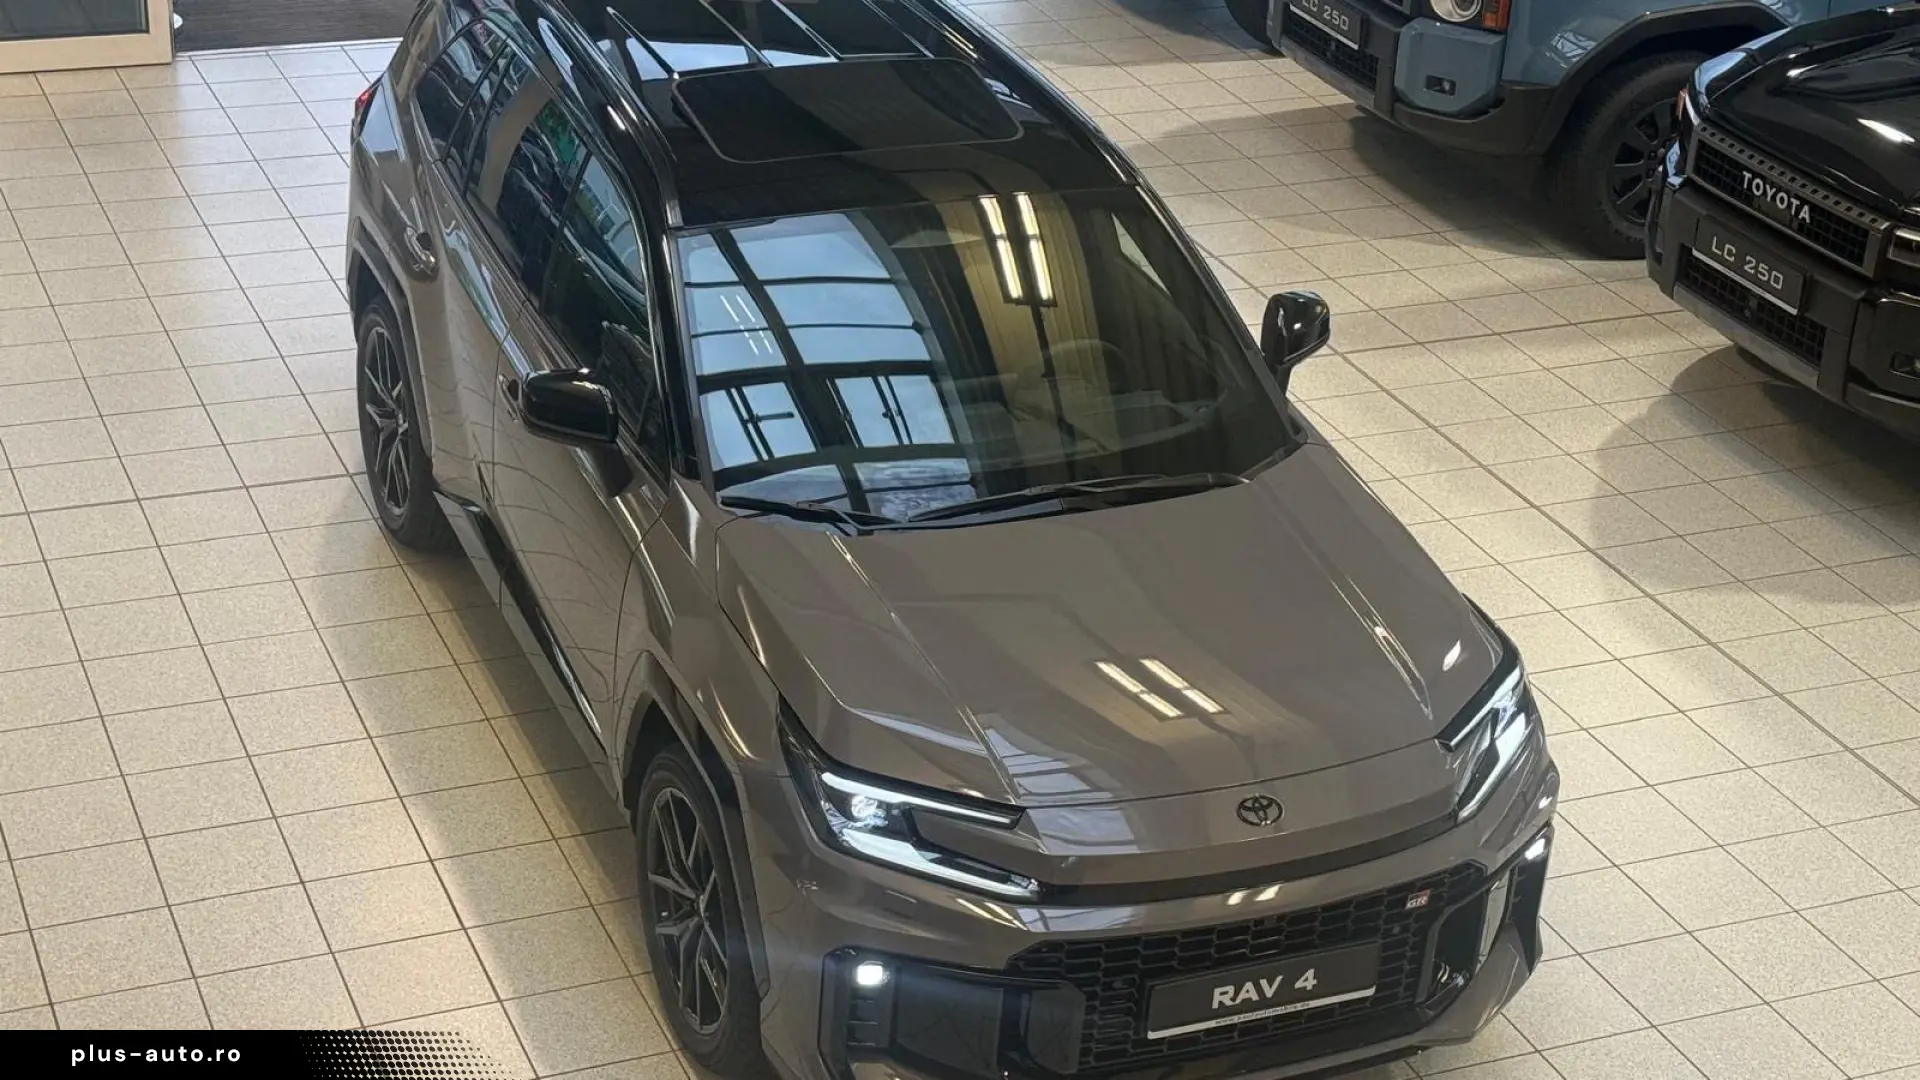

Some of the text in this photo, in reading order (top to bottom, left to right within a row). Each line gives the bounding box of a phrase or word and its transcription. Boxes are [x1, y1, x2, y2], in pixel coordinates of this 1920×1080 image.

[1323, 5, 1350, 31] 250
[1742, 170, 1811, 223] TOYOTA
[1711, 236, 1784, 290] LC 250
[1405, 893, 1430, 909] GR
[1212, 968, 1318, 1009] RAV 4
